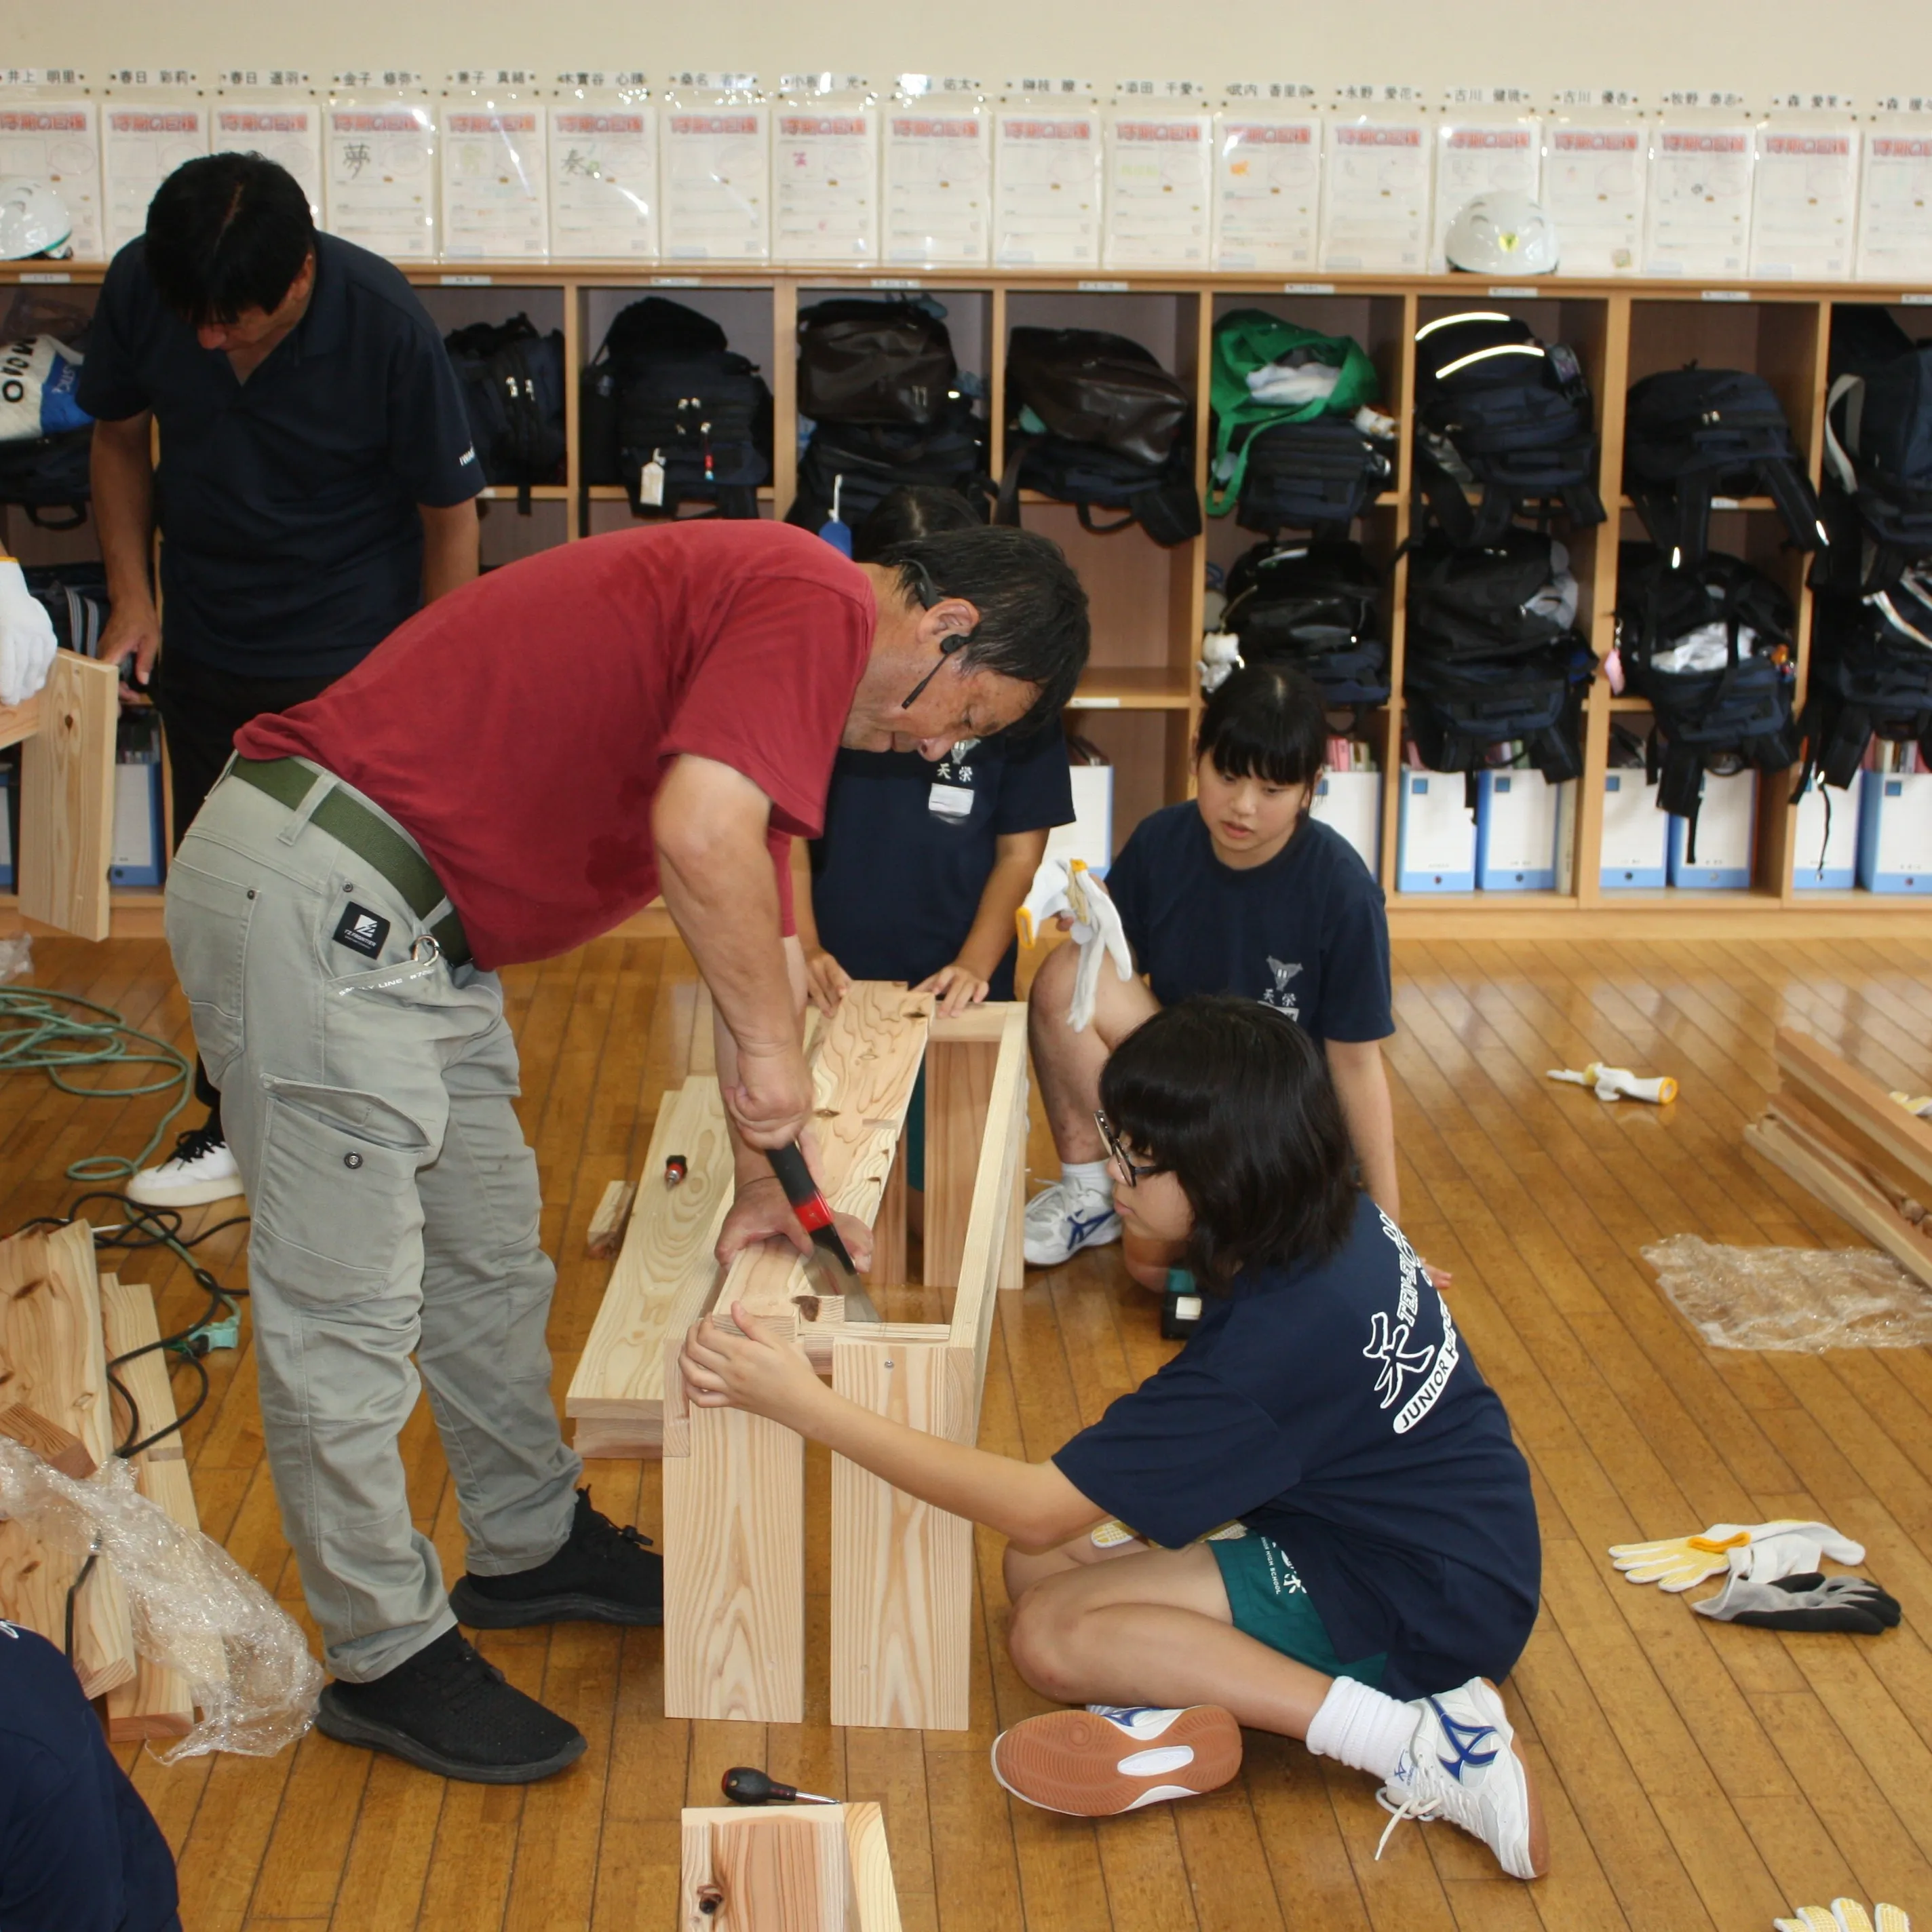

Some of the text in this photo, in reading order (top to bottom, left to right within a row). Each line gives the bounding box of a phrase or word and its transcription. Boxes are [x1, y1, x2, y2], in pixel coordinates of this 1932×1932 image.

[8, 70, 35, 84] 井上
[120, 71, 147, 84] 春日
[343, 71, 372, 85] 金子
[343, 142, 370, 180] 夢
[937, 762, 973, 782] 天栄
[1402, 1359, 1450, 1429] JUNIOR
[1269, 1568, 1281, 1595] SCHOOL
